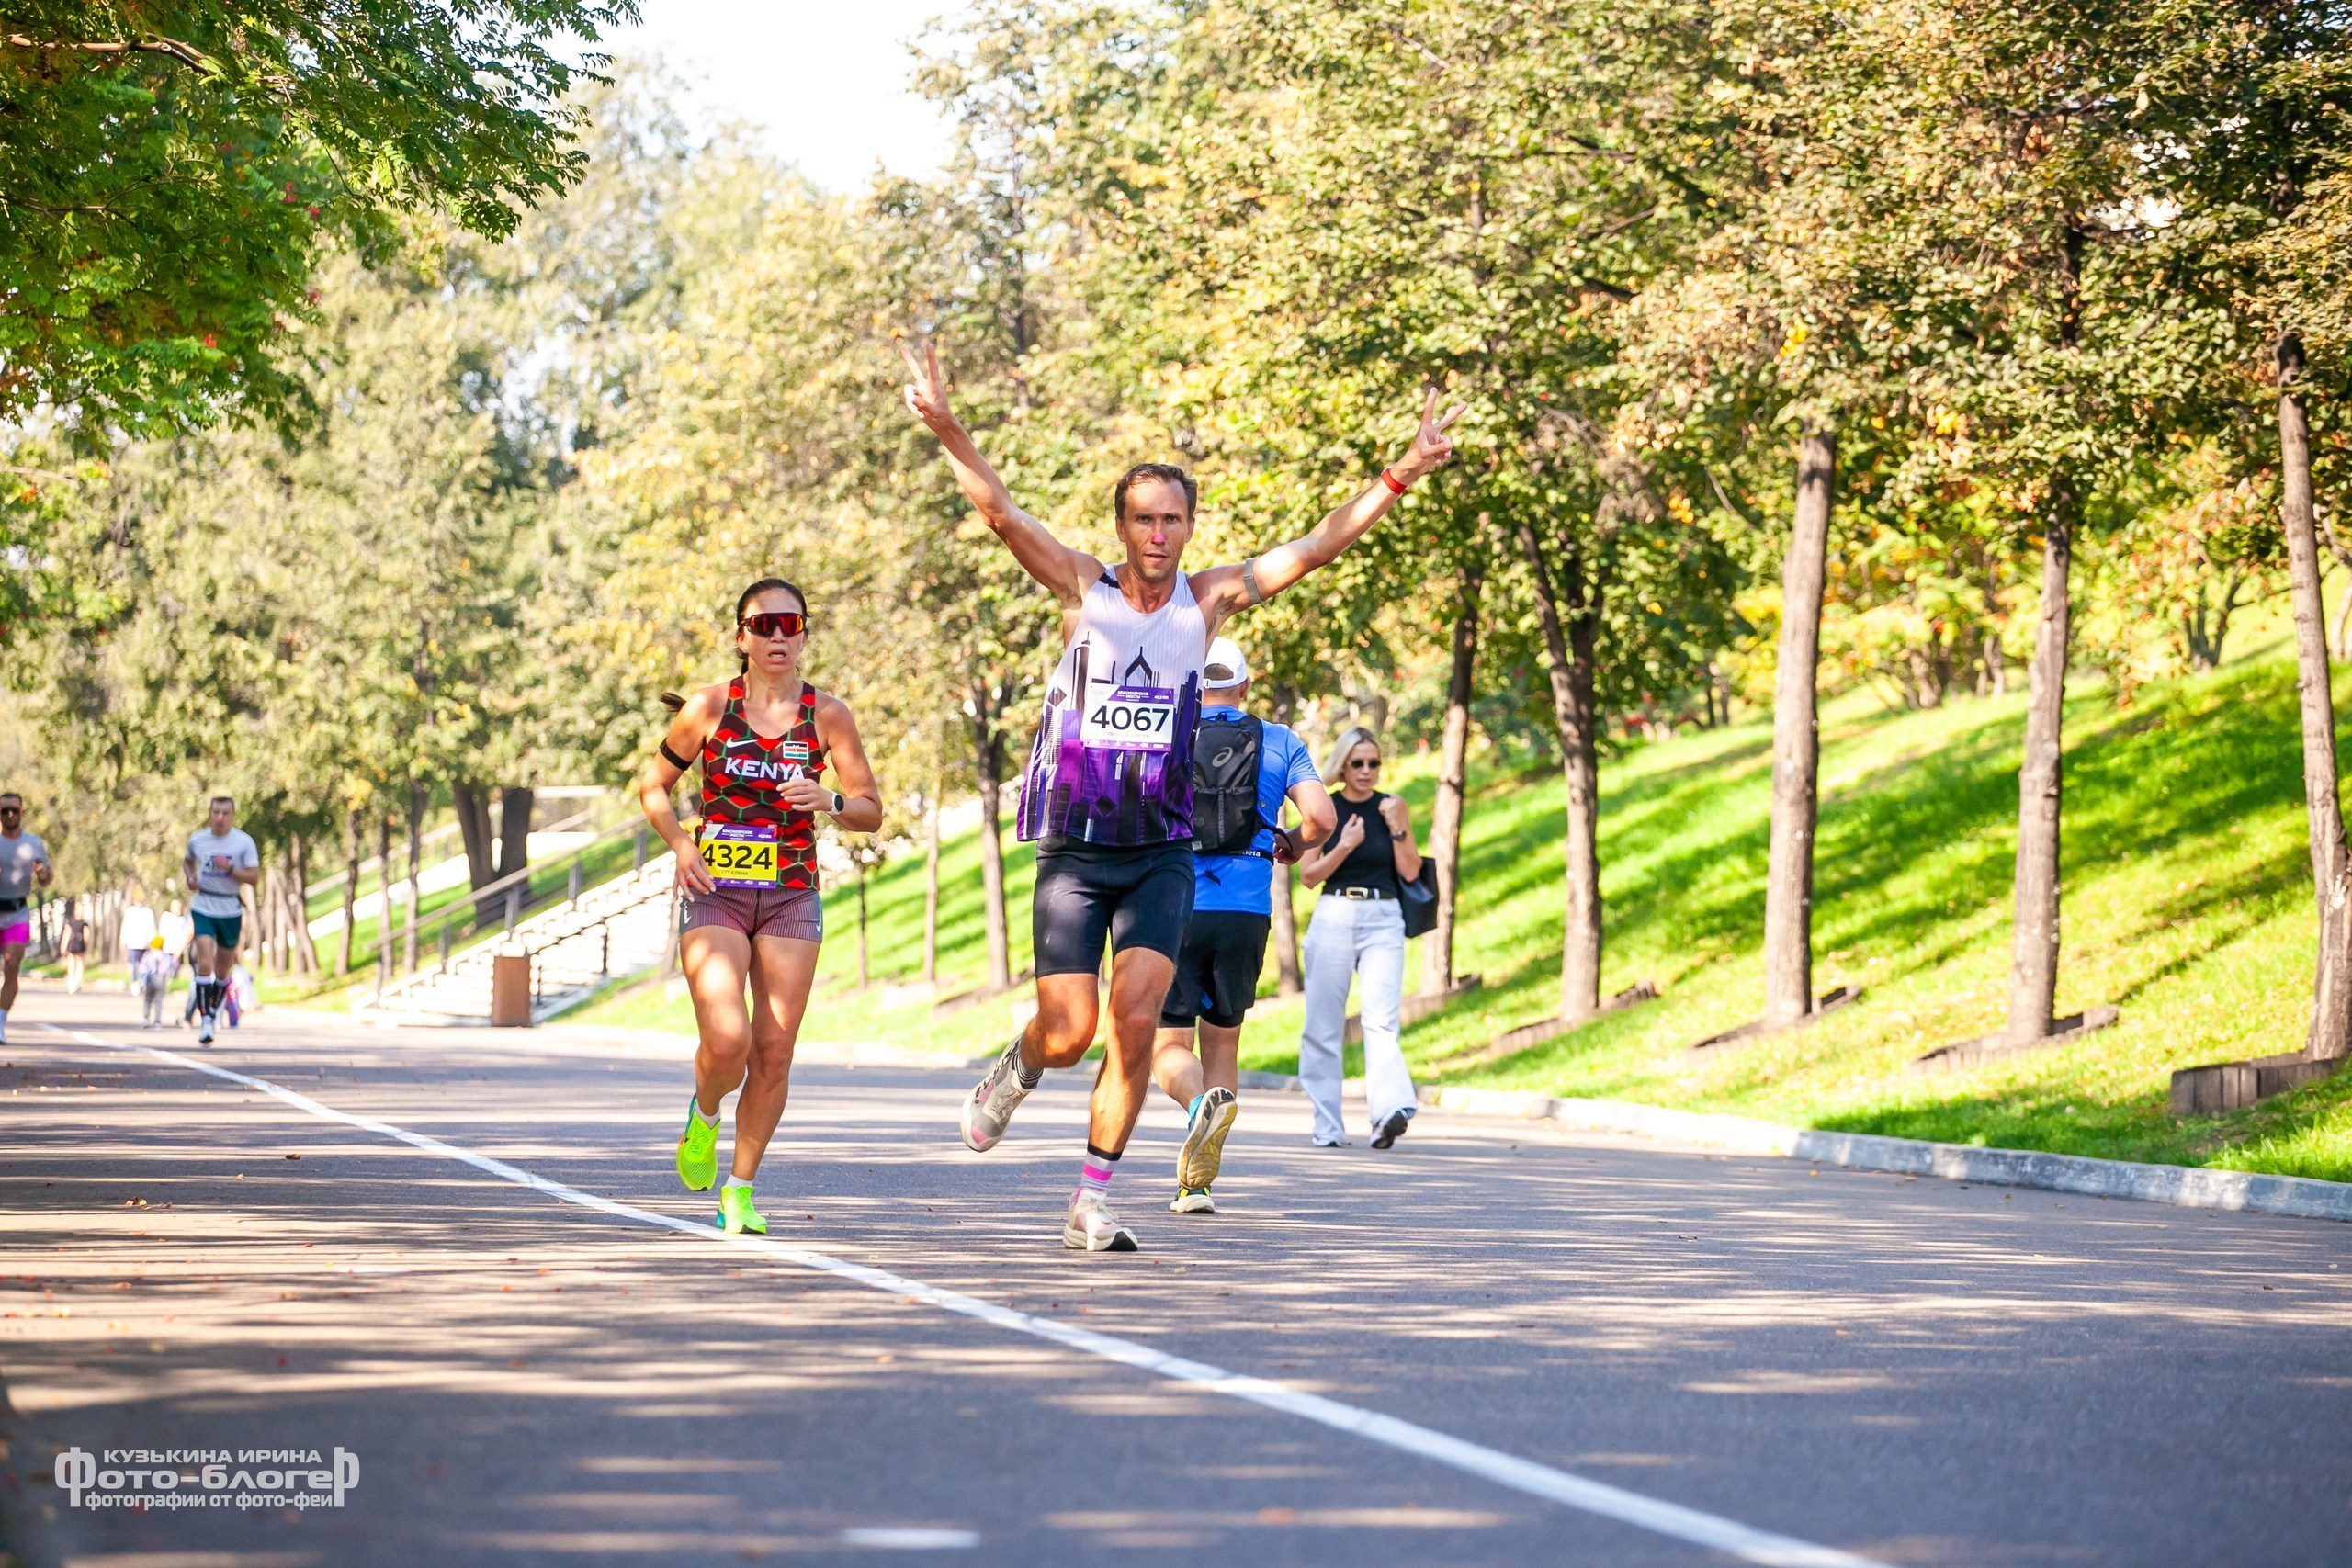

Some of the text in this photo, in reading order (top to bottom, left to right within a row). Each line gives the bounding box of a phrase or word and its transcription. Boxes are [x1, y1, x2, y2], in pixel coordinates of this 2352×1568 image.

[1090, 705, 1170, 732] 4067
[724, 757, 805, 780] KENYA
[702, 843, 773, 870] 4324
